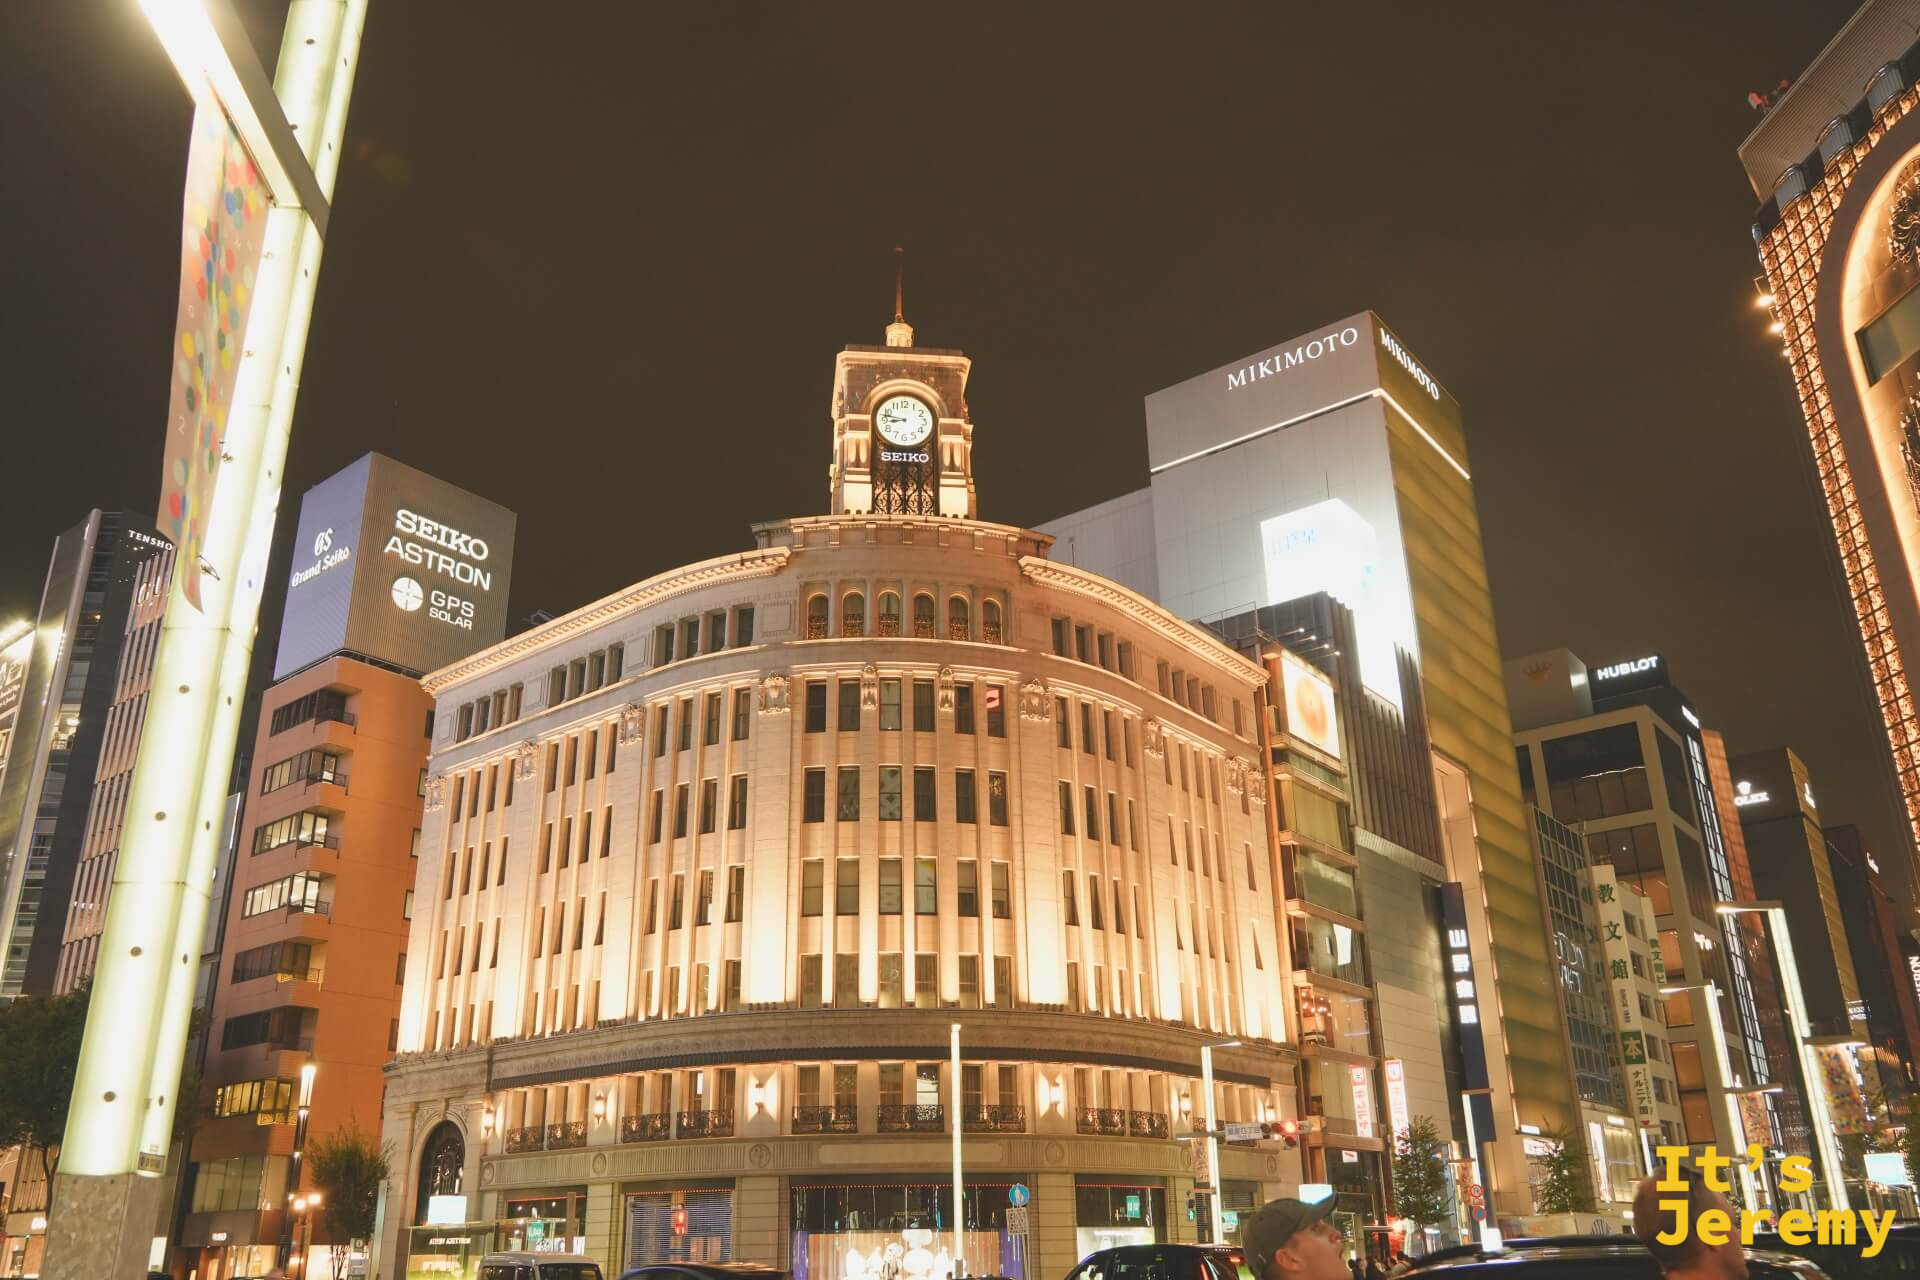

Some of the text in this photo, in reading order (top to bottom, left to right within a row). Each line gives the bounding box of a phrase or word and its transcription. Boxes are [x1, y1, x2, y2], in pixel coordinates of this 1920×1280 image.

[1226, 327, 1358, 390] MIKIMOTO
[1380, 327, 1440, 400] MIKIMOTO
[892, 402, 899, 411] 11
[901, 400, 909, 409] 12
[884, 407, 892, 417] 10
[918, 409, 924, 418] 2
[881, 416, 889, 424] 9
[921, 418, 928, 426] 3
[885, 424, 892, 433] 8
[893, 430, 899, 439] 7
[917, 426, 925, 434] 4
[901, 433, 907, 442] 6
[911, 431, 917, 440] 5
[881, 451, 929, 463] SEIKO
[128, 529, 173, 551] TENSHO
[395, 509, 489, 561] SEIKO
[314, 528, 334, 556] GS
[291, 546, 351, 587] Grand Seiko
[384, 535, 491, 591] ASTRON
[430, 590, 474, 618] GPS
[429, 607, 473, 631] SOLAR
[1597, 656, 1658, 680] HUBLOT
[1623, 1036, 1642, 1060] 本
